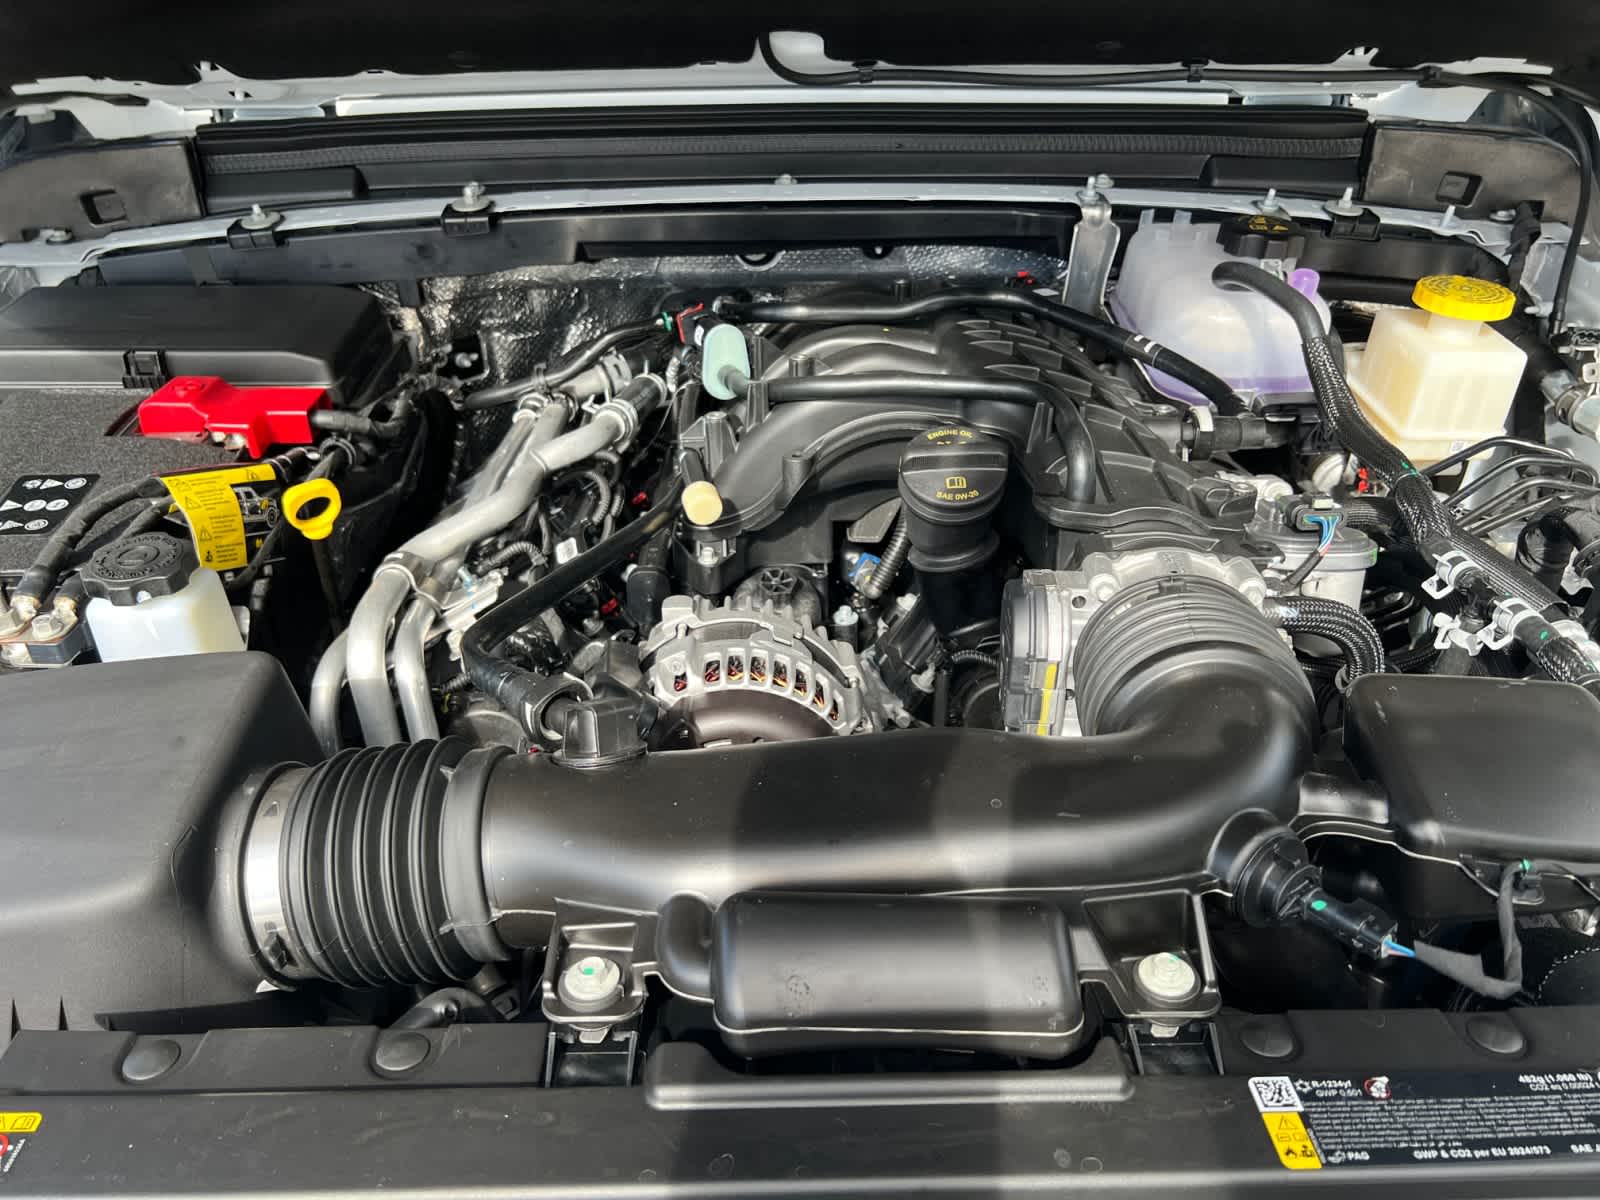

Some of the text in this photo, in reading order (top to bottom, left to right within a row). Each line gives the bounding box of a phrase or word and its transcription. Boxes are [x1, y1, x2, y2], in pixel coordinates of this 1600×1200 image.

[927, 428, 973, 440] ENGINE OIL
[936, 489, 980, 501] SAE 0W-20
[1529, 1083, 1550, 1091] CO2
[1315, 1089, 1337, 1097] GWP
[1413, 1149, 1439, 1160] GWP
[1440, 1149, 1450, 1159] &
[1450, 1148, 1473, 1158] CO2
[1473, 1149, 1490, 1159] per
[1491, 1147, 1507, 1157] EU
[1570, 1143, 1594, 1154] SAE
